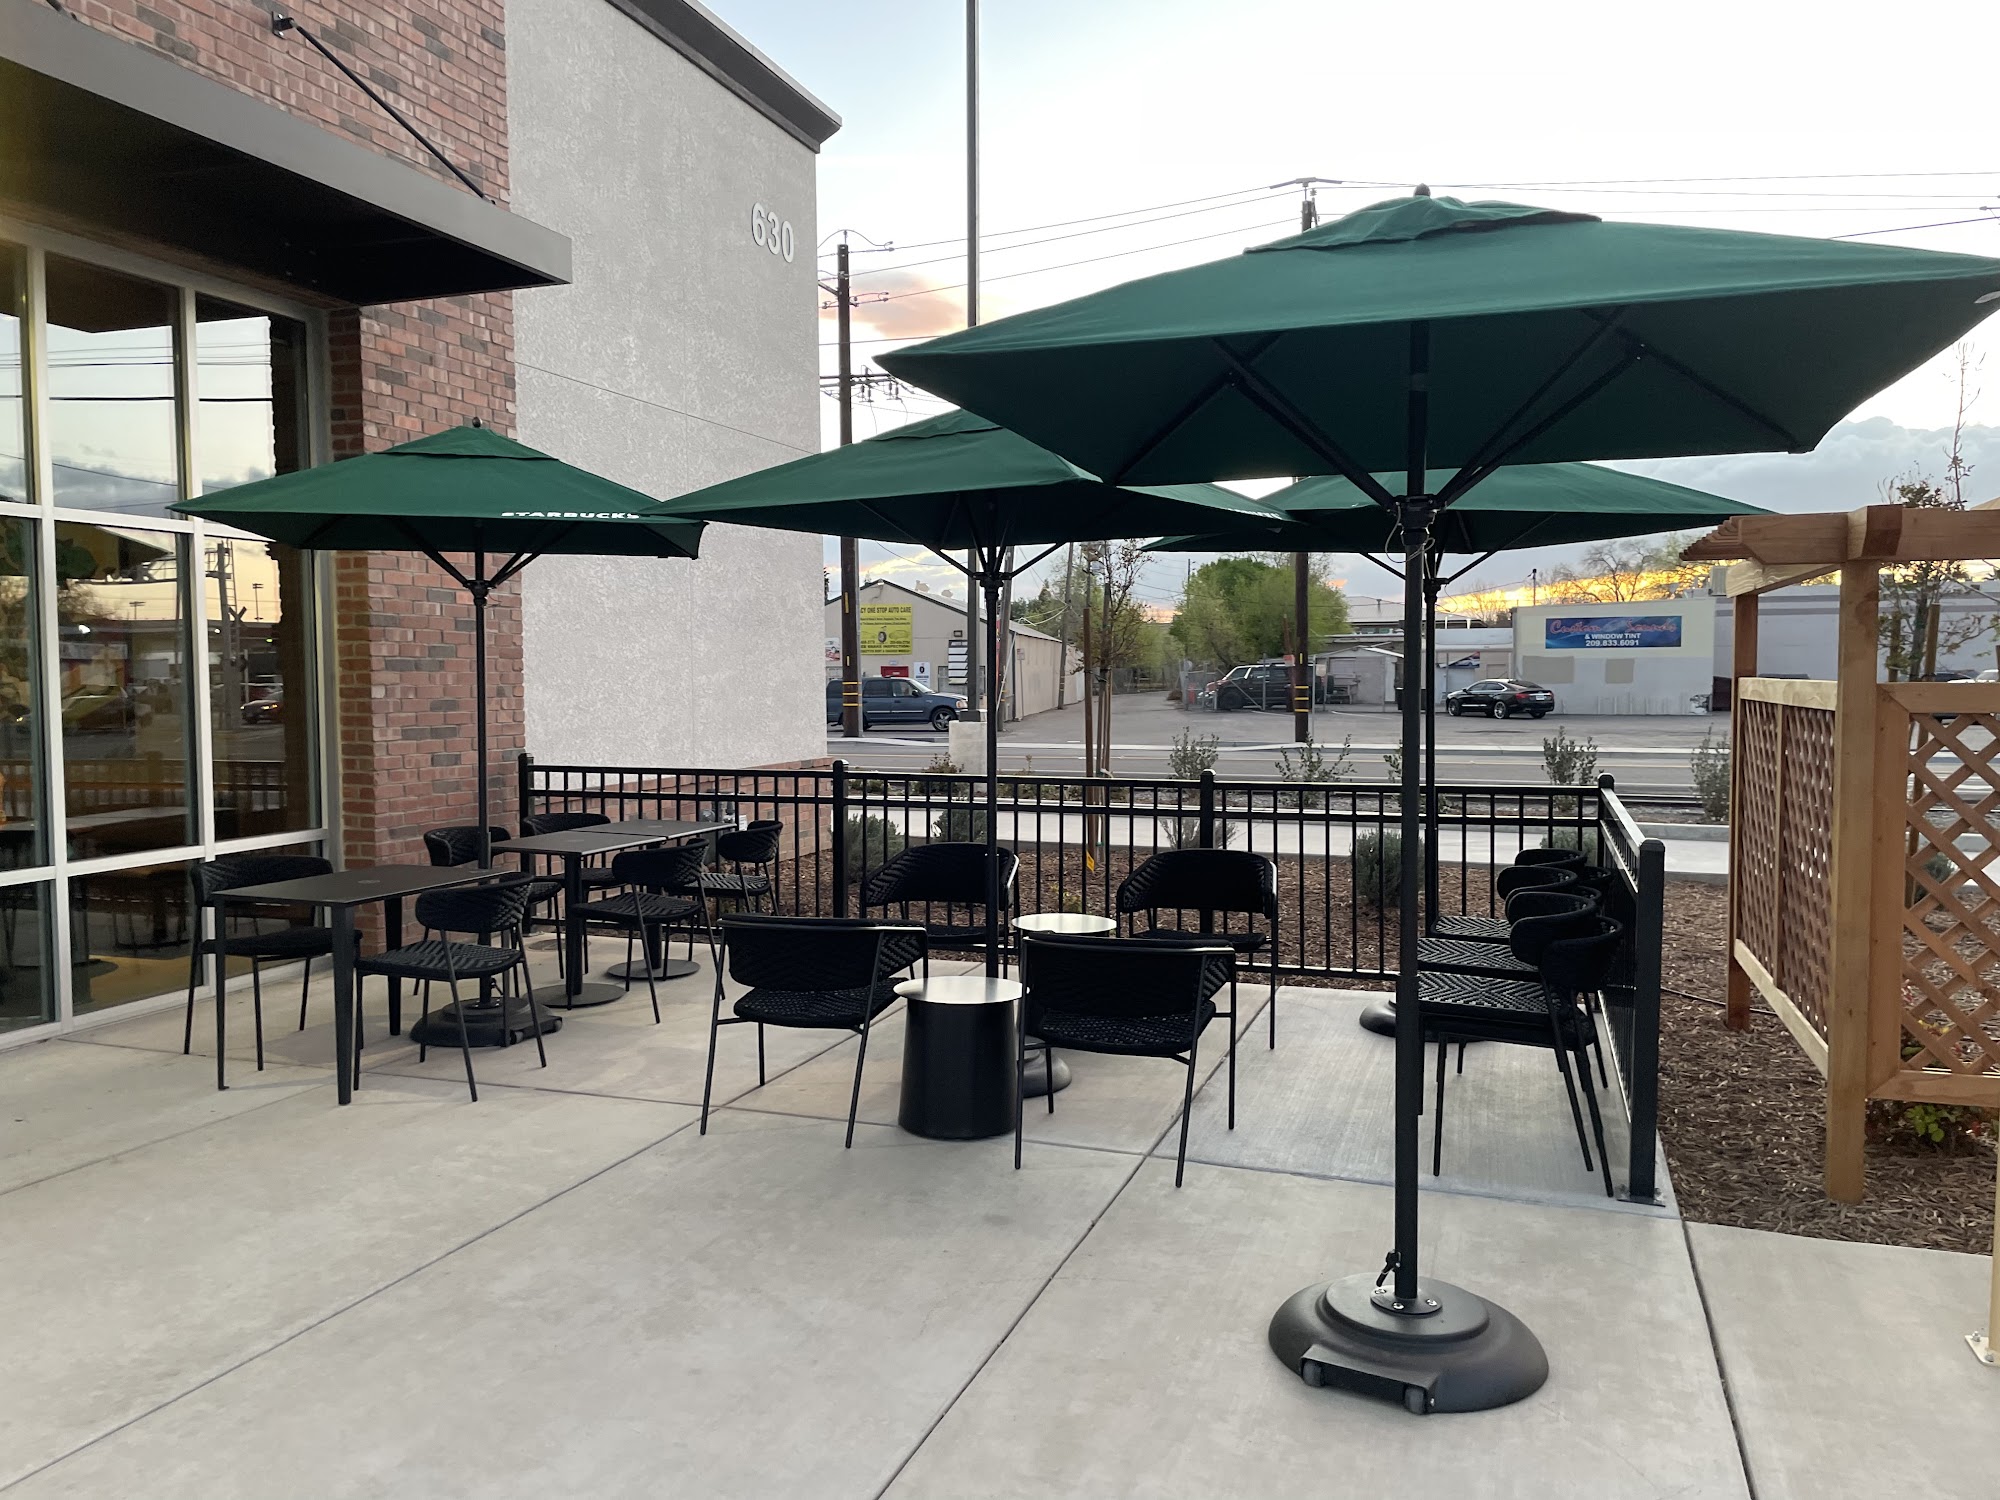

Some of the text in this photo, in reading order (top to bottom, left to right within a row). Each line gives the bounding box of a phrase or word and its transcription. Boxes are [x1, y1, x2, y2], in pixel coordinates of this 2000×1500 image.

[751, 202, 795, 263] 630
[501, 511, 640, 519] STARBUCKS
[1550, 617, 1678, 634] Custom Sounds
[1585, 639, 1640, 647] 209.833.6091
